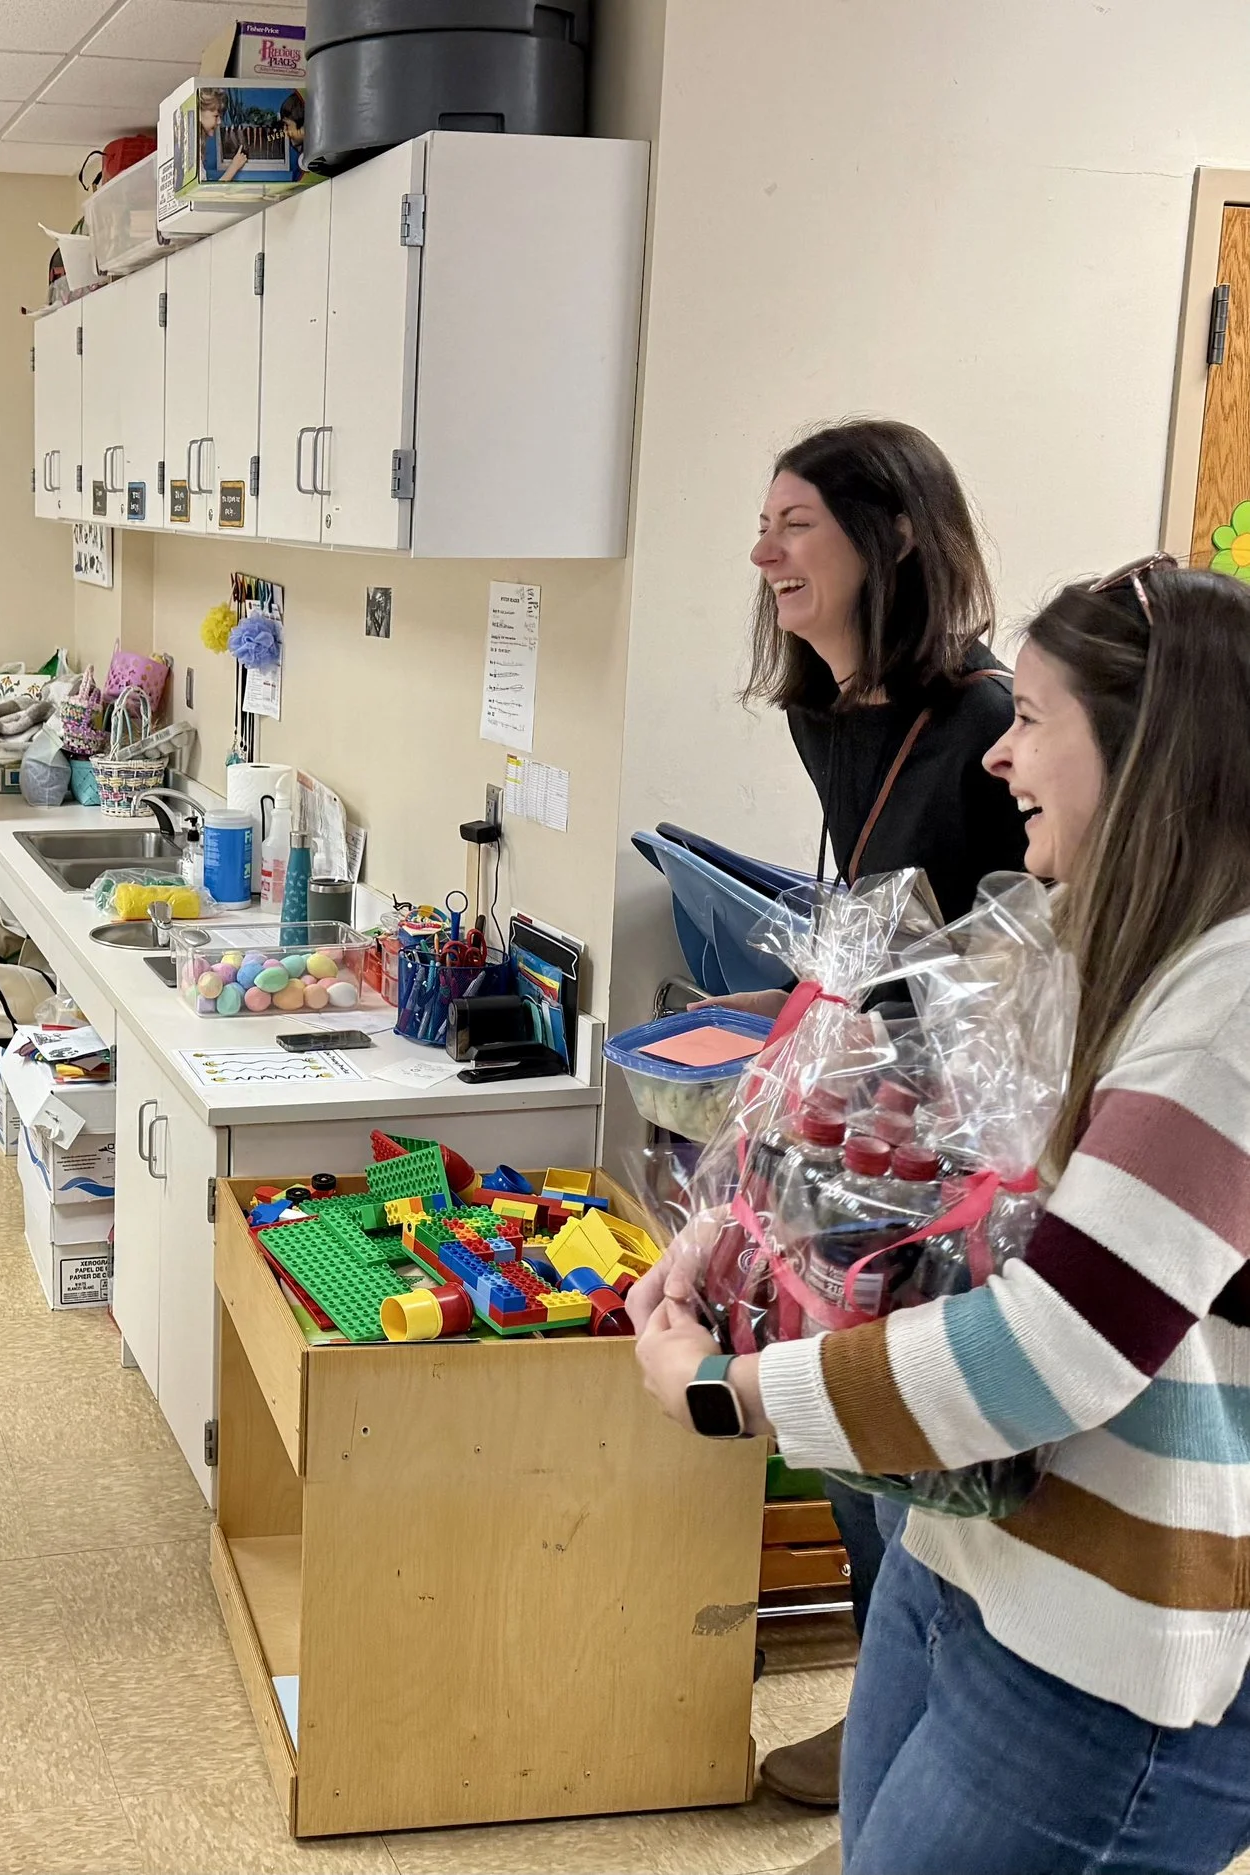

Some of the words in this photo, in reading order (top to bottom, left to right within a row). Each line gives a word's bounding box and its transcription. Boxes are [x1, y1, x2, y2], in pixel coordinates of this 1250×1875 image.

[246, 25, 280, 34] Fisher-Price
[268, 57, 297, 69] PLACES
[69, 1273, 92, 1281] PAPIER
